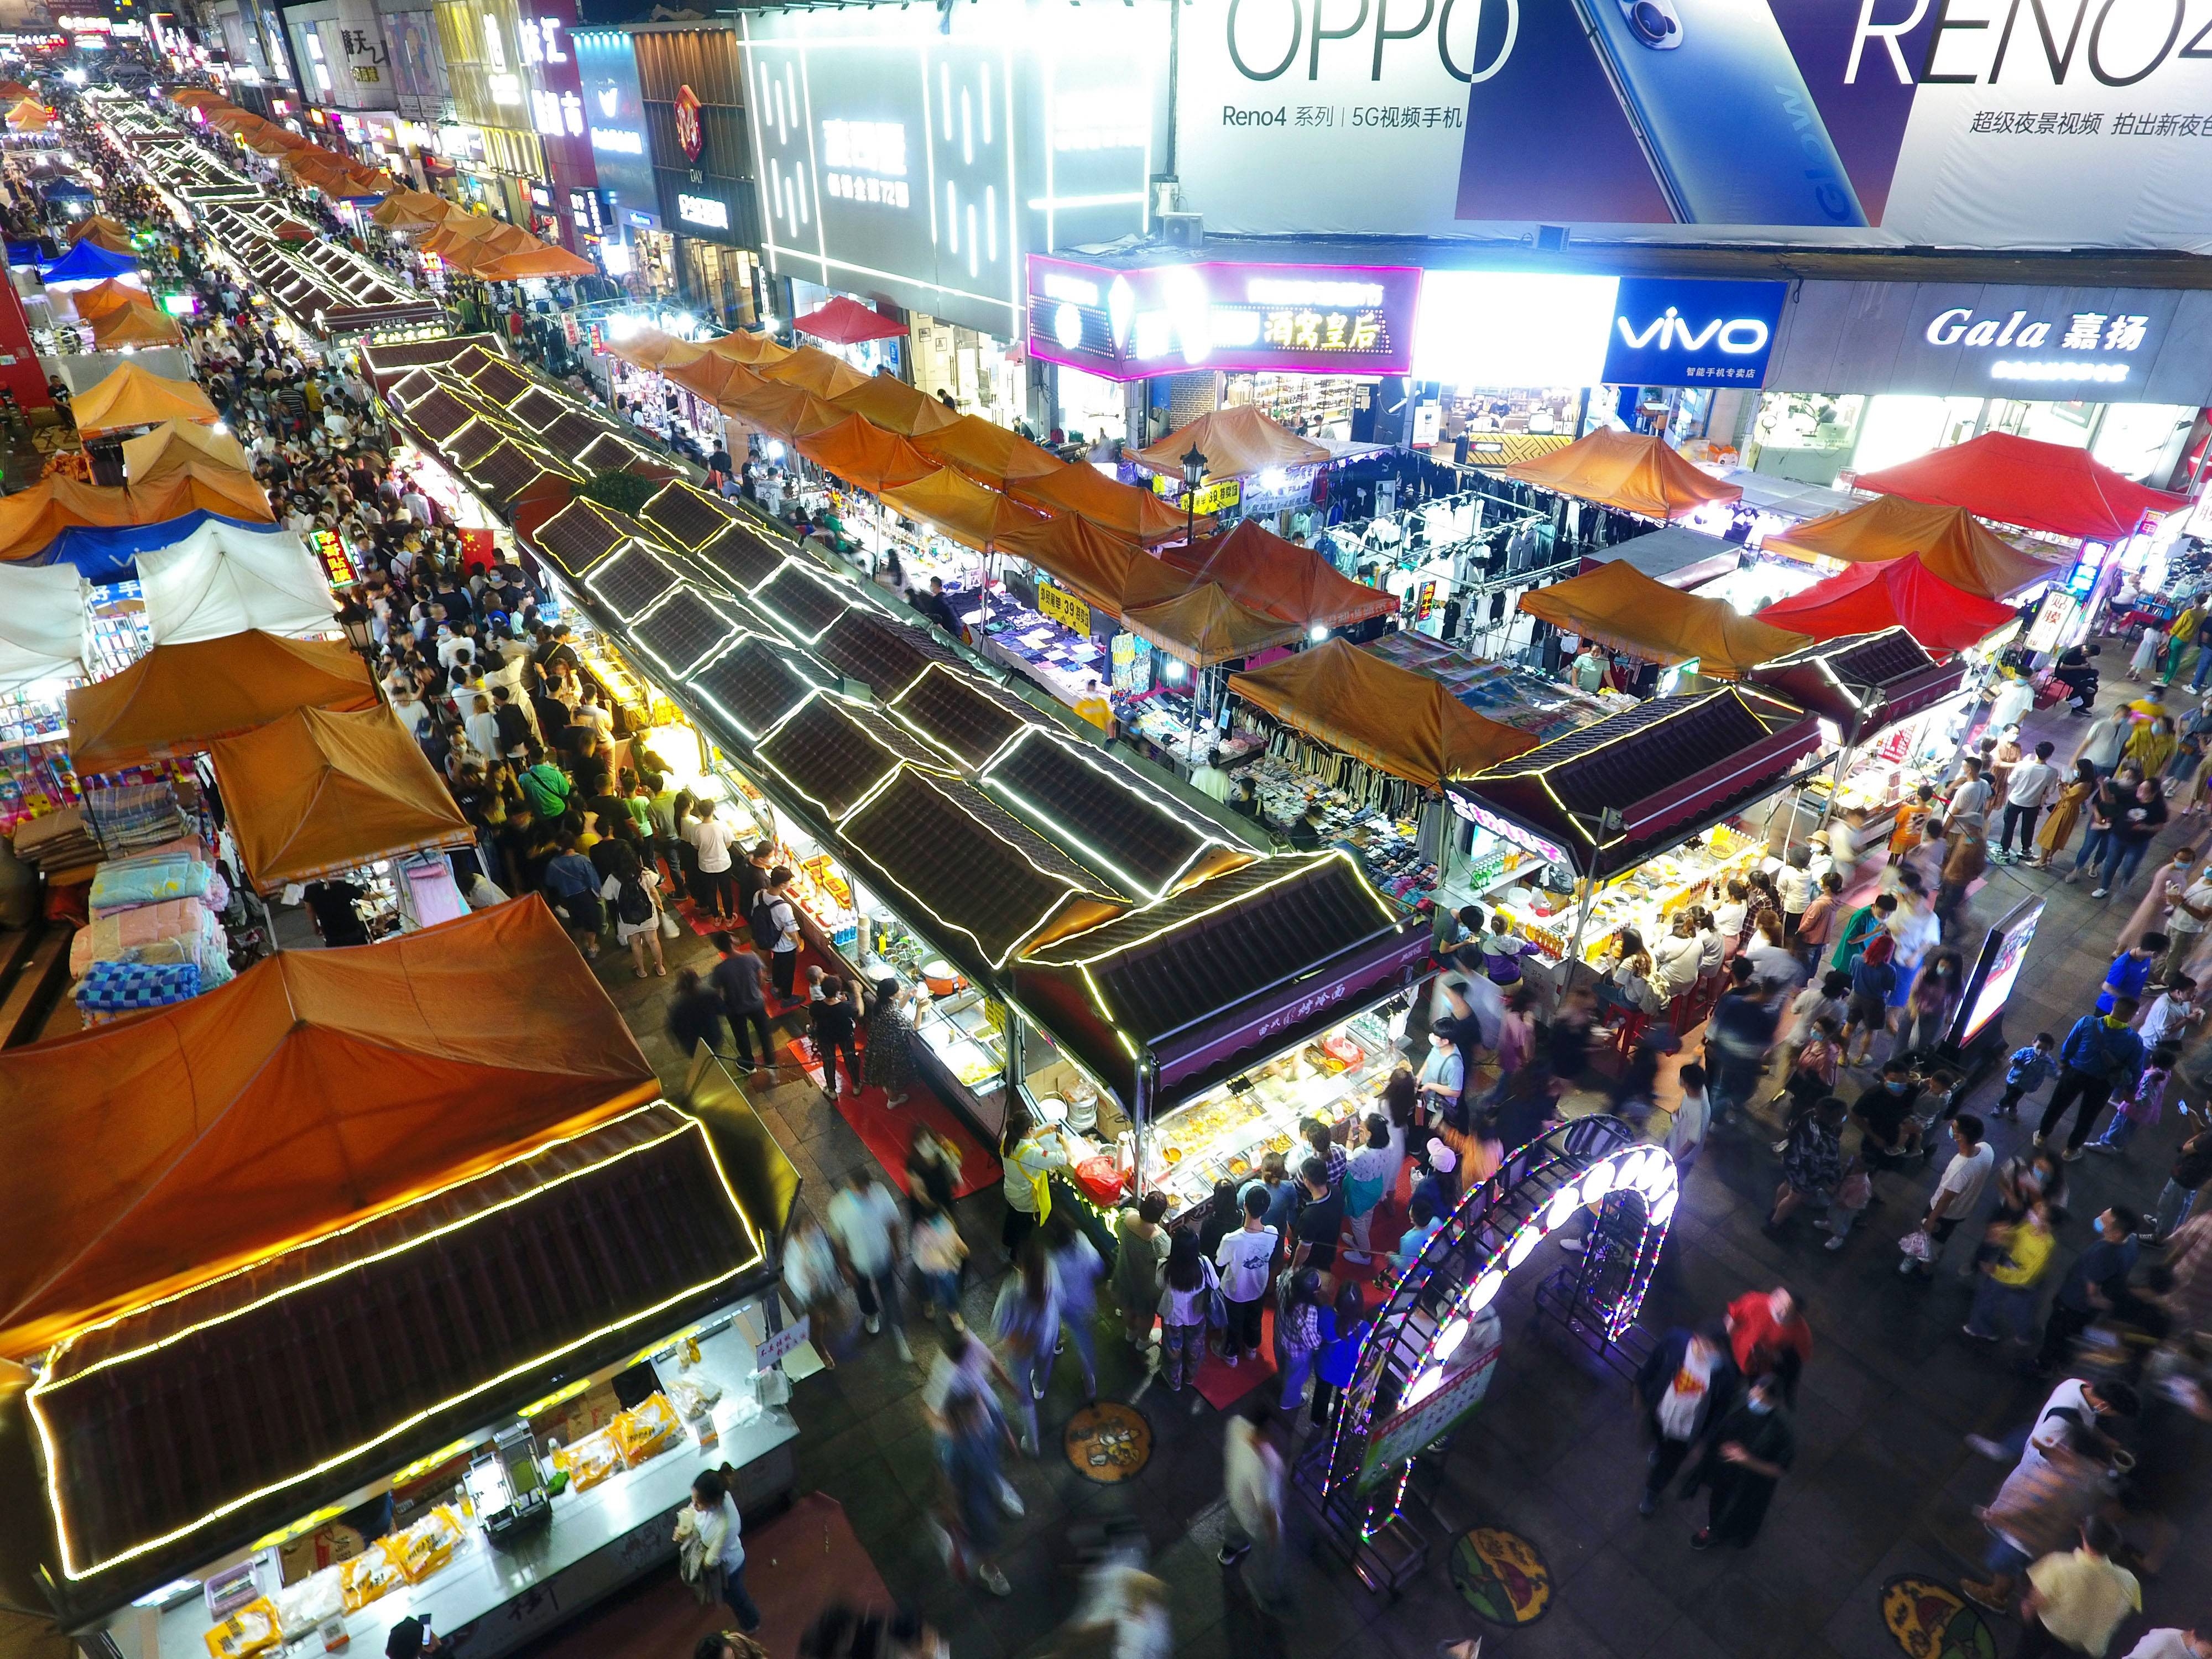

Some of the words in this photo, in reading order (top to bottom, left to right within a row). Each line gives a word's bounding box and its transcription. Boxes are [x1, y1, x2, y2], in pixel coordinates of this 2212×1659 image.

[1227, 0, 1519, 84] OPPO
[1222, 105, 1287, 127] Reno4
[1294, 105, 1334, 127] 系列
[1352, 106, 1463, 129] 5G视频手机
[1969, 111, 2104, 135] 超级夜景视频
[1617, 306, 1769, 354] vivo
[1926, 307, 2052, 349] Gala
[2060, 311, 2150, 351] 嘉扬
[1686, 366, 1756, 379] 智能手机专卖店
[1064, 599, 1074, 617] 39
